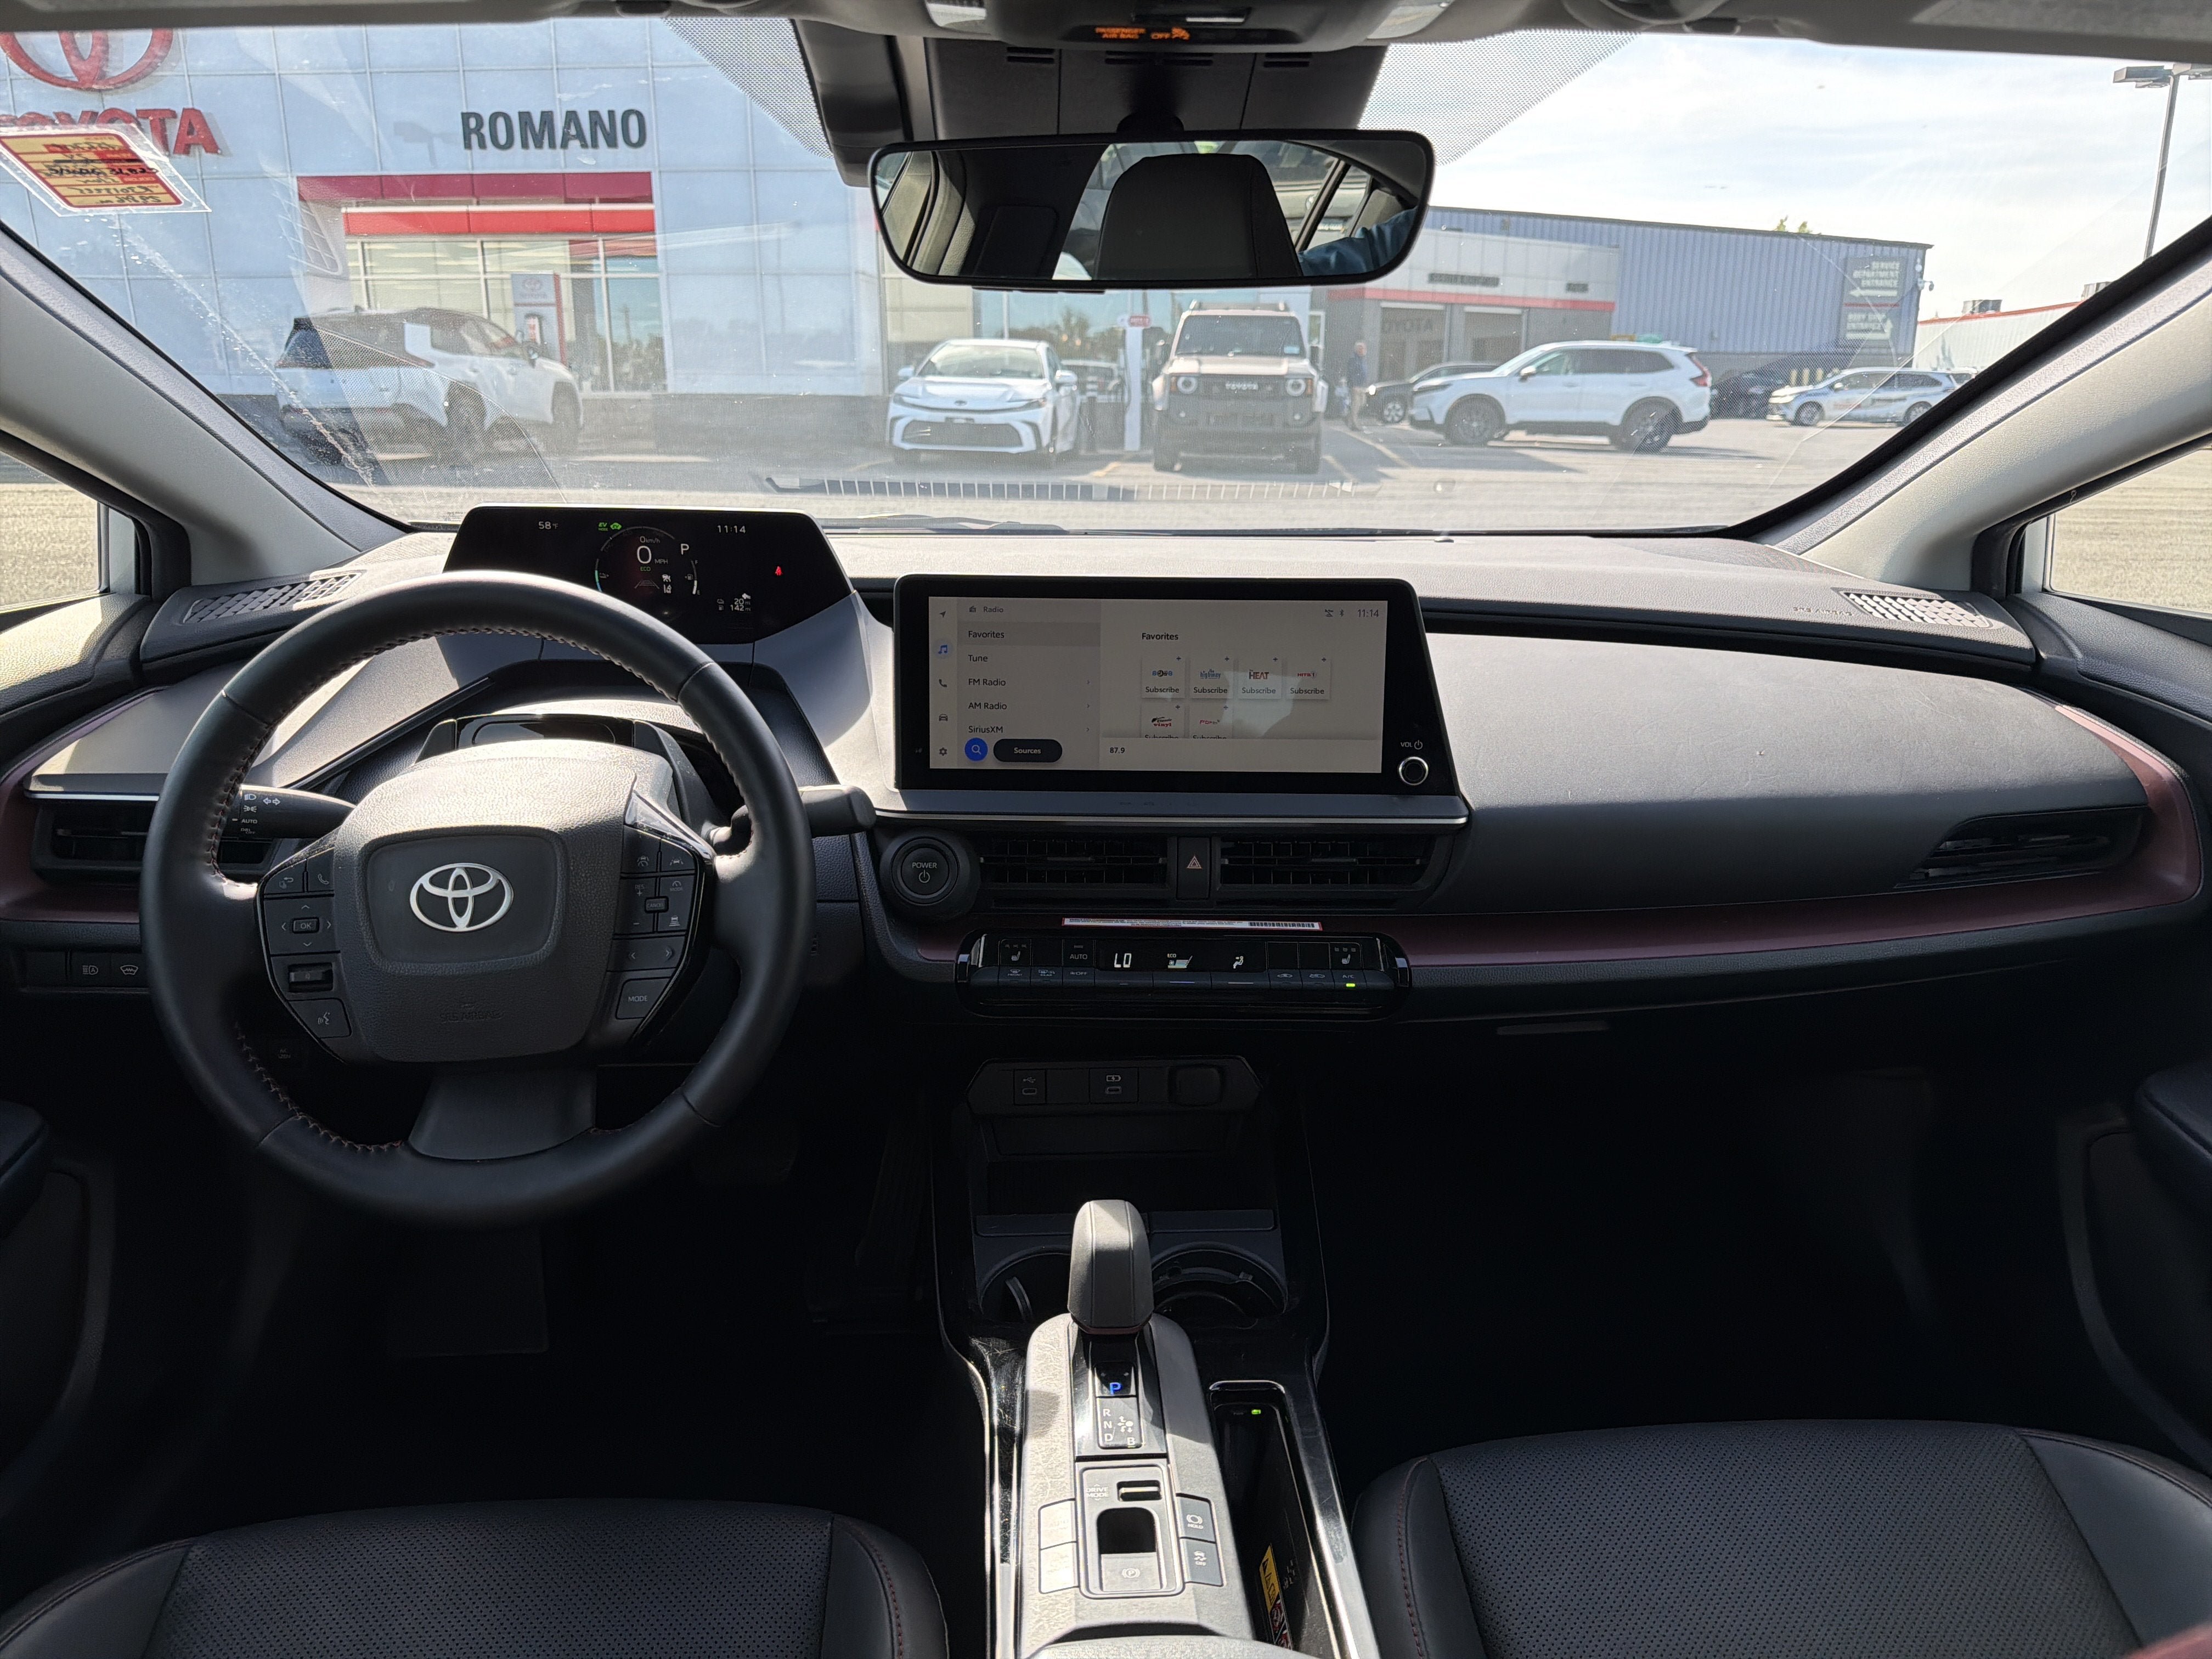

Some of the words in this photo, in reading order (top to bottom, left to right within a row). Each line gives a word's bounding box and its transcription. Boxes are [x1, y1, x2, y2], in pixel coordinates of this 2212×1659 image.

[461, 109, 647, 150] ROMANO
[717, 525, 746, 533] 11:14
[680, 543, 690, 555] P
[637, 545, 652, 564] 0
[1357, 609, 1380, 618] 11:14
[968, 630, 1005, 639] Favorites
[1142, 633, 1179, 641] Favorites
[1200, 670, 1221, 679] highway
[1249, 672, 1269, 680] HEAT
[983, 678, 1006, 686] Radio
[1114, 953, 1132, 968] LO
[1110, 1382, 1121, 1395] P
[1103, 1408, 1111, 1417] R
[1104, 1421, 1113, 1429] N
[1104, 1433, 1113, 1442] D
[1127, 1437, 1136, 1446] B
